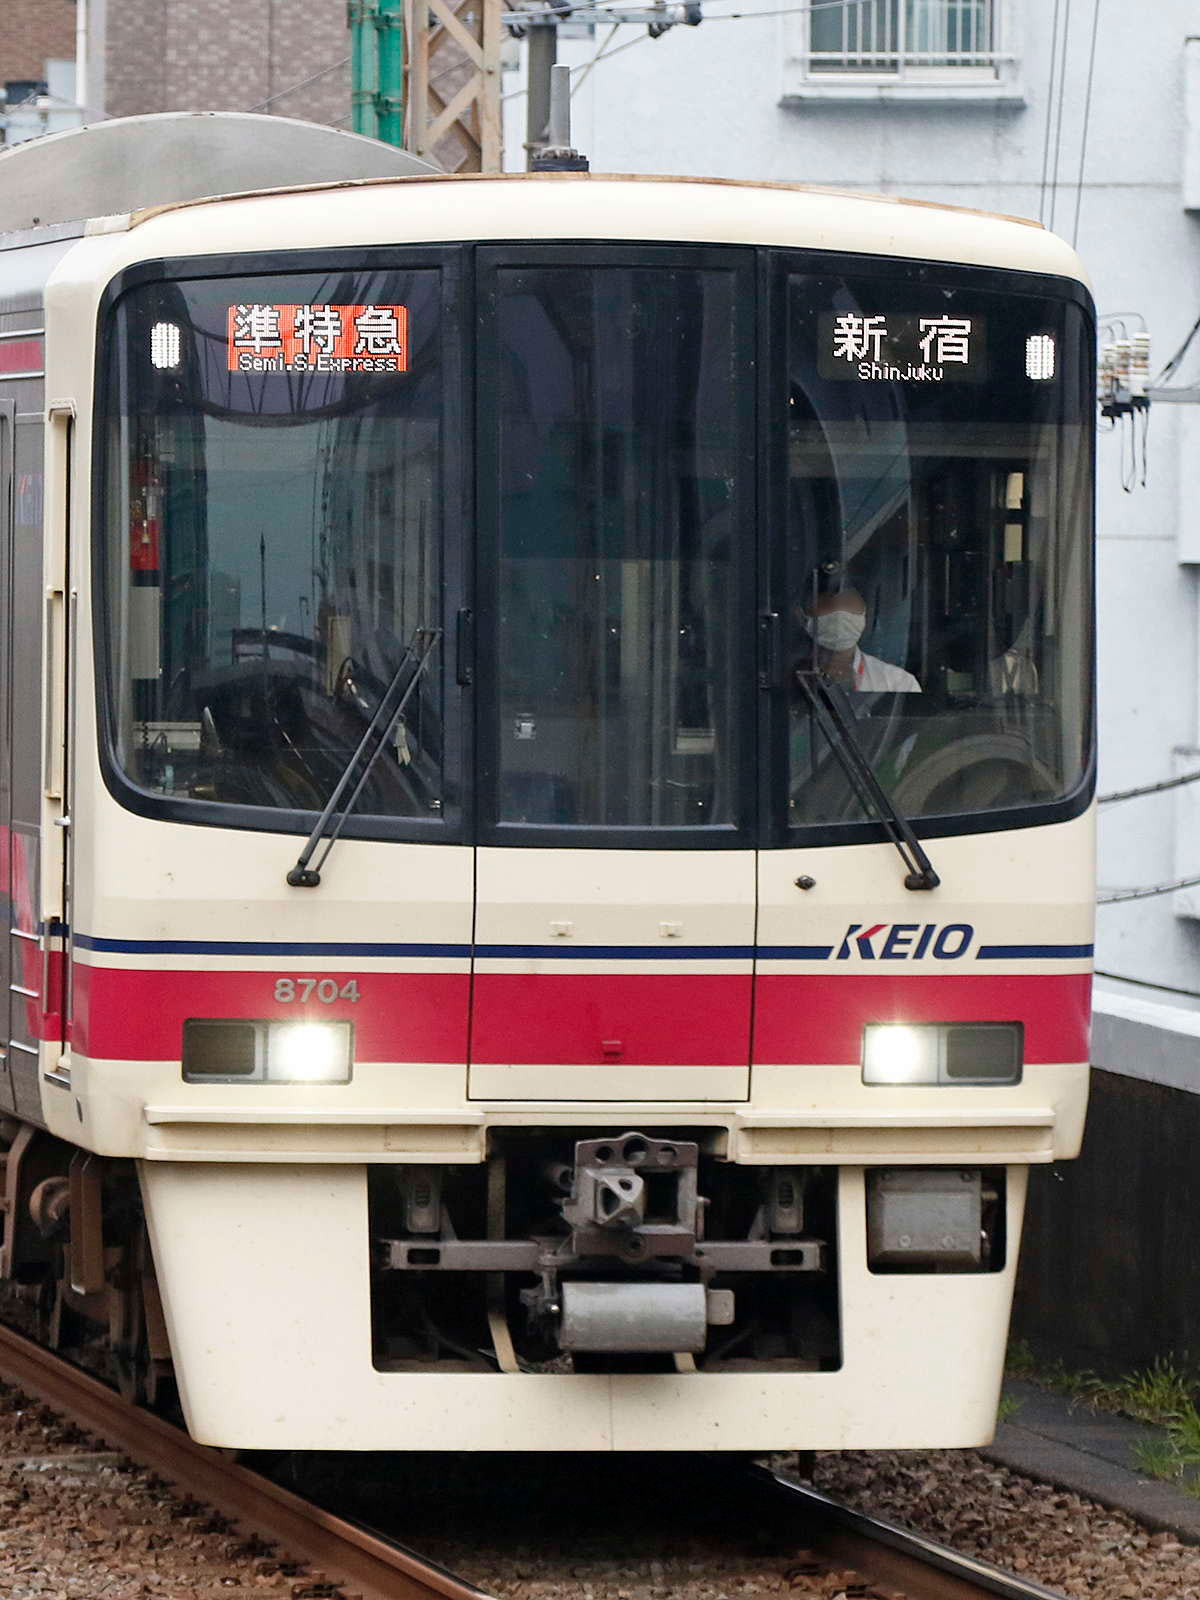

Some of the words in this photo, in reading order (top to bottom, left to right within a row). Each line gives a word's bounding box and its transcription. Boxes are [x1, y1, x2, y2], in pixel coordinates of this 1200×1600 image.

[234, 304, 401, 354] 準特急
[833, 313, 972, 364] 新宿
[857, 362, 944, 382] Shinjuku
[836, 923, 975, 960] KEIO
[274, 978, 361, 1004] 8704
